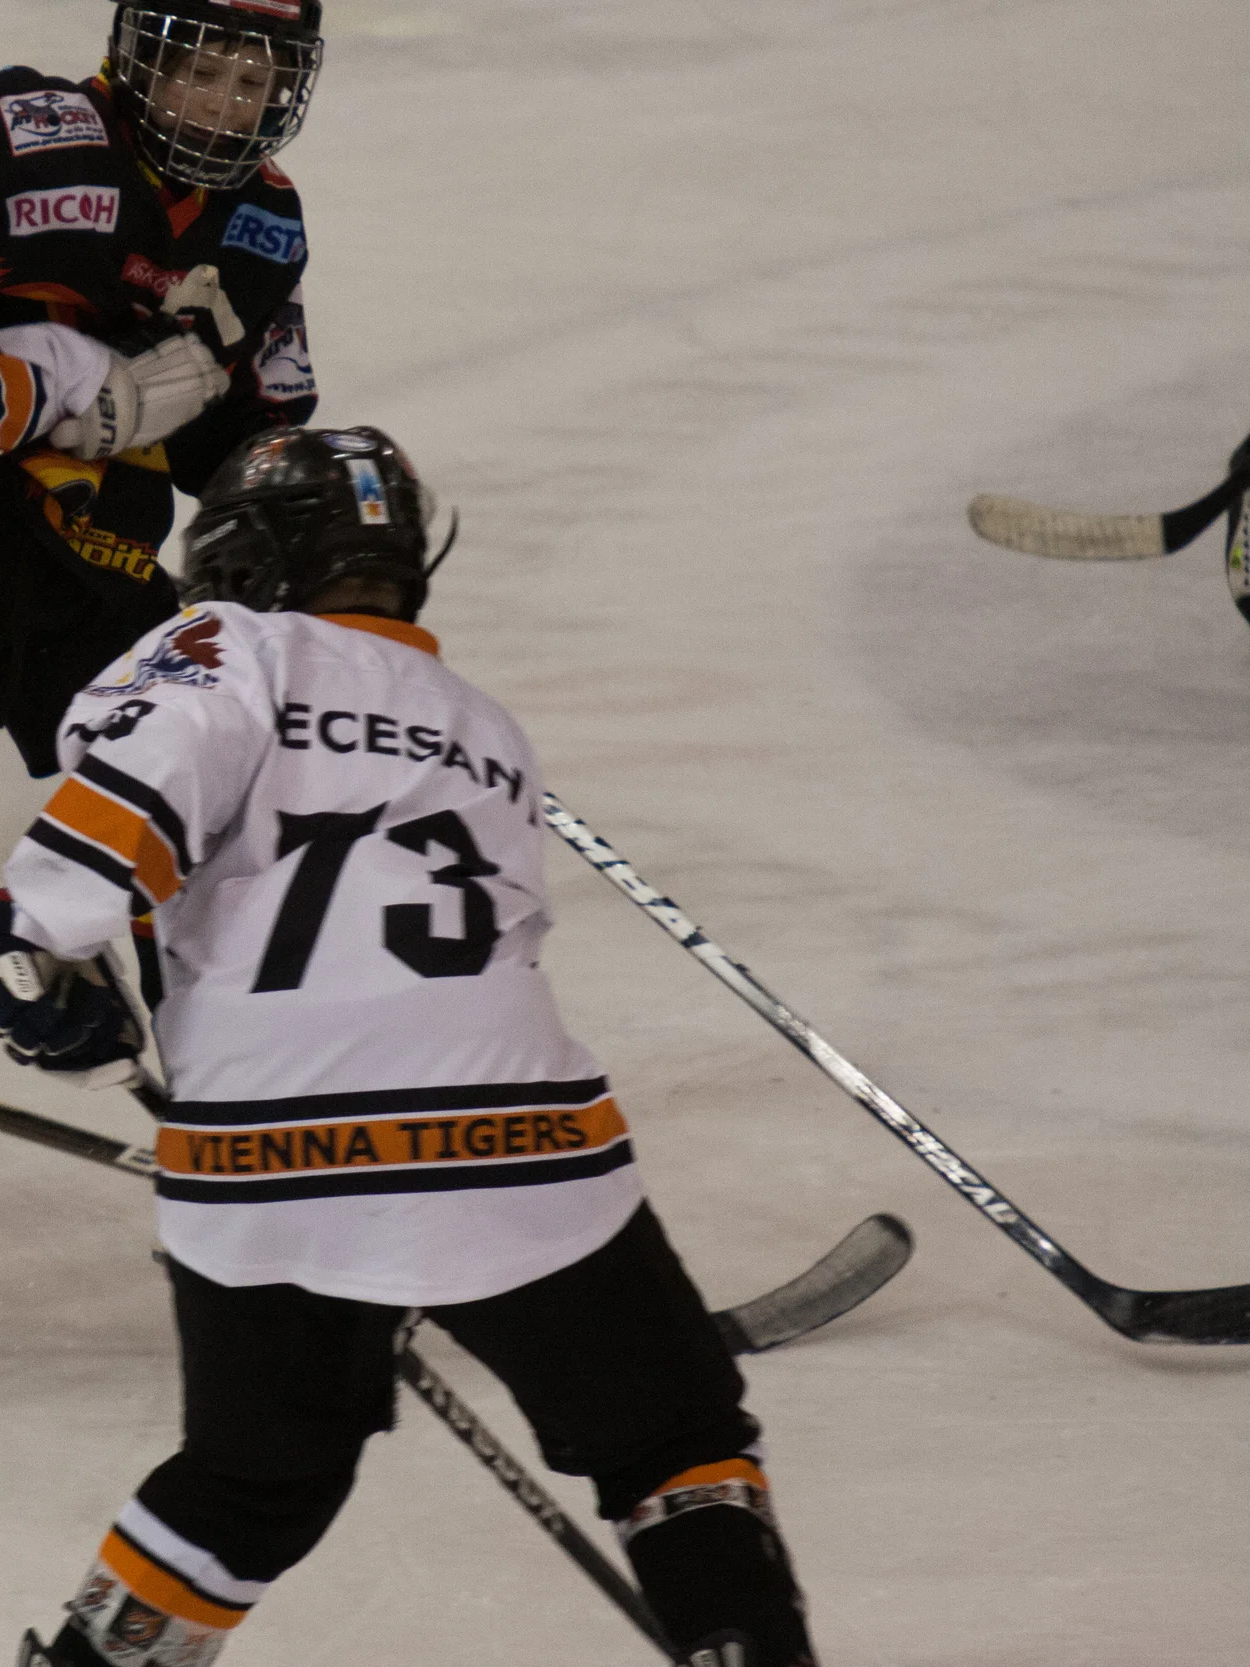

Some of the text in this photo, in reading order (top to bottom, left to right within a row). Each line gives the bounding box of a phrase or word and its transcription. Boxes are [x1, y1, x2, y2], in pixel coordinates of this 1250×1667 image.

[14, 192, 115, 227] RICOH
[276, 702, 530, 820] ECESAN
[249, 800, 501, 993] 73
[187, 1112, 586, 1174] VIENNA TIGERS
